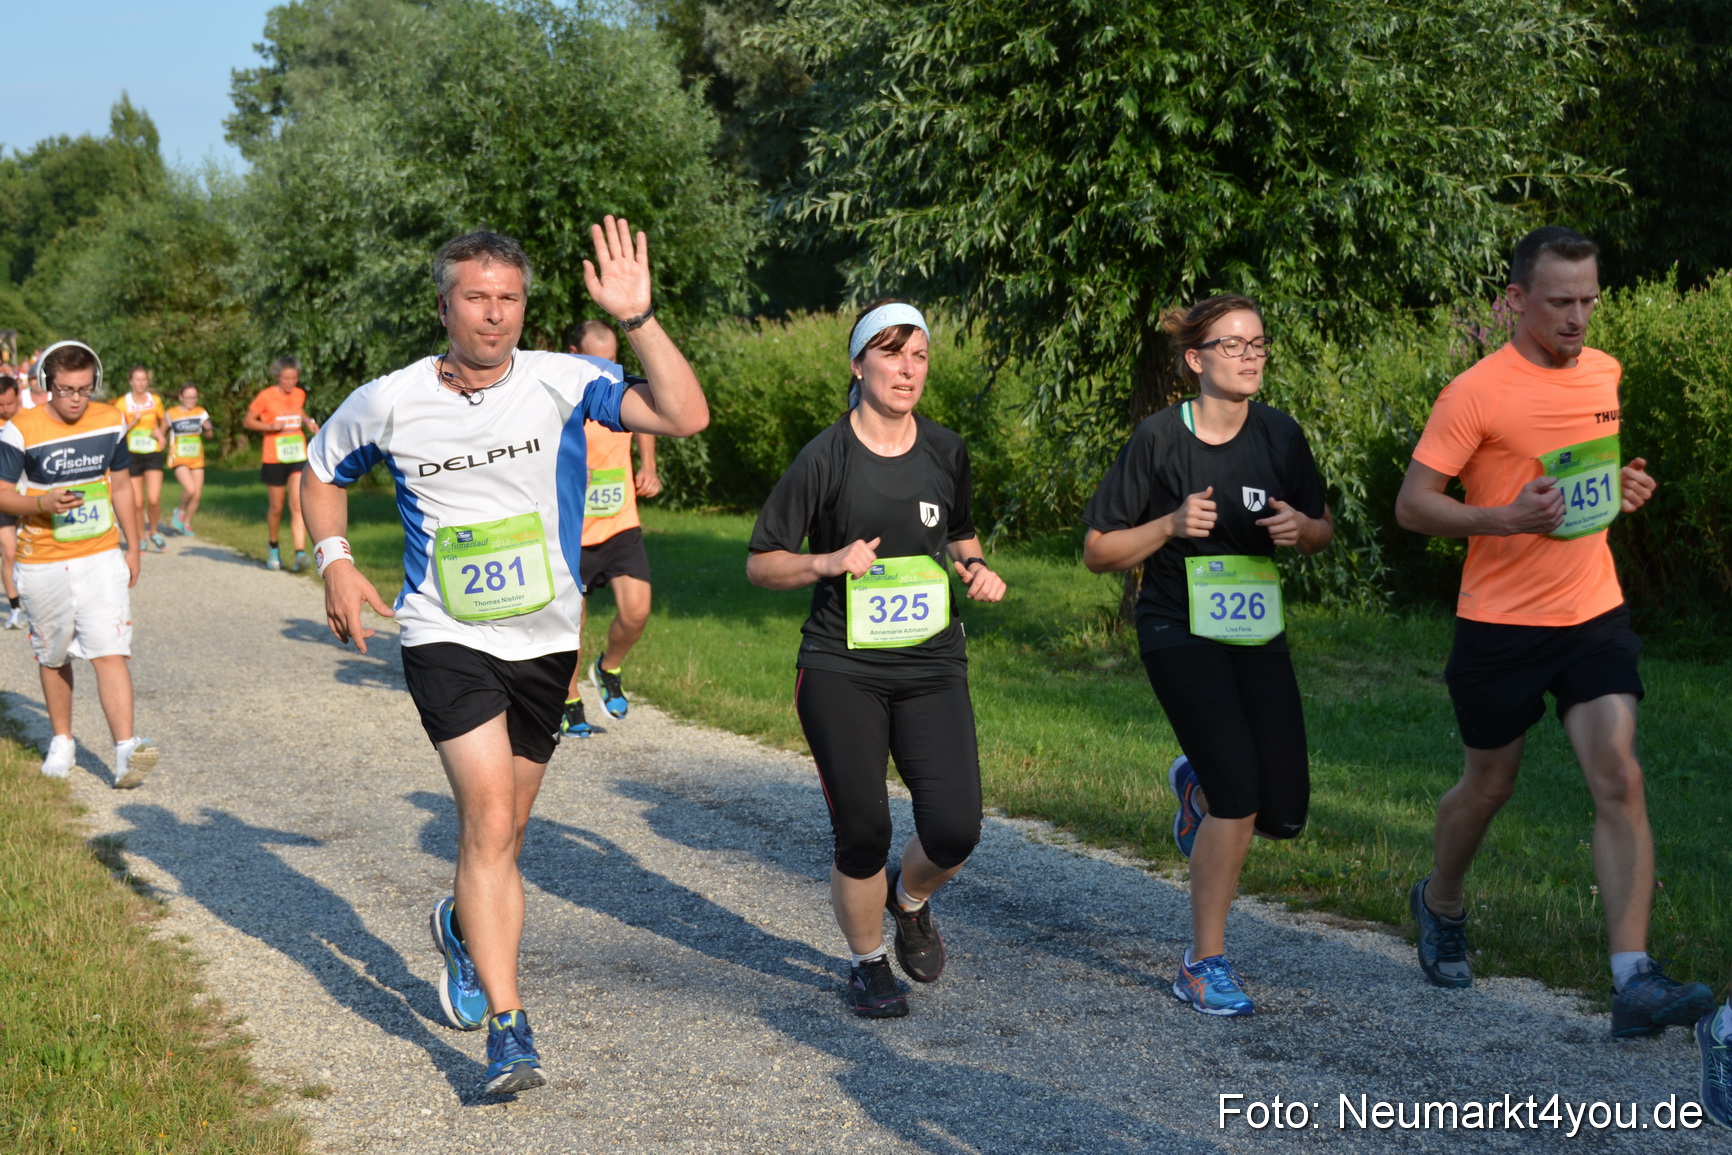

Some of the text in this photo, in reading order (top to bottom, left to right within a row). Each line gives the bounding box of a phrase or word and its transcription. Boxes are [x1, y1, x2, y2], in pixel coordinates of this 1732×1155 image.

[55, 454, 105, 471] Fischer
[418, 438, 541, 478] DELPHI
[589, 487, 622, 504] 455
[64, 505, 100, 524] 454
[451, 538, 488, 549] firmenlauf
[461, 556, 525, 595] 281
[474, 594, 525, 607] Thomas Niebler
[869, 593, 929, 623] 325
[1209, 592, 1266, 620] 326
[870, 628, 902, 636] Annemarie
